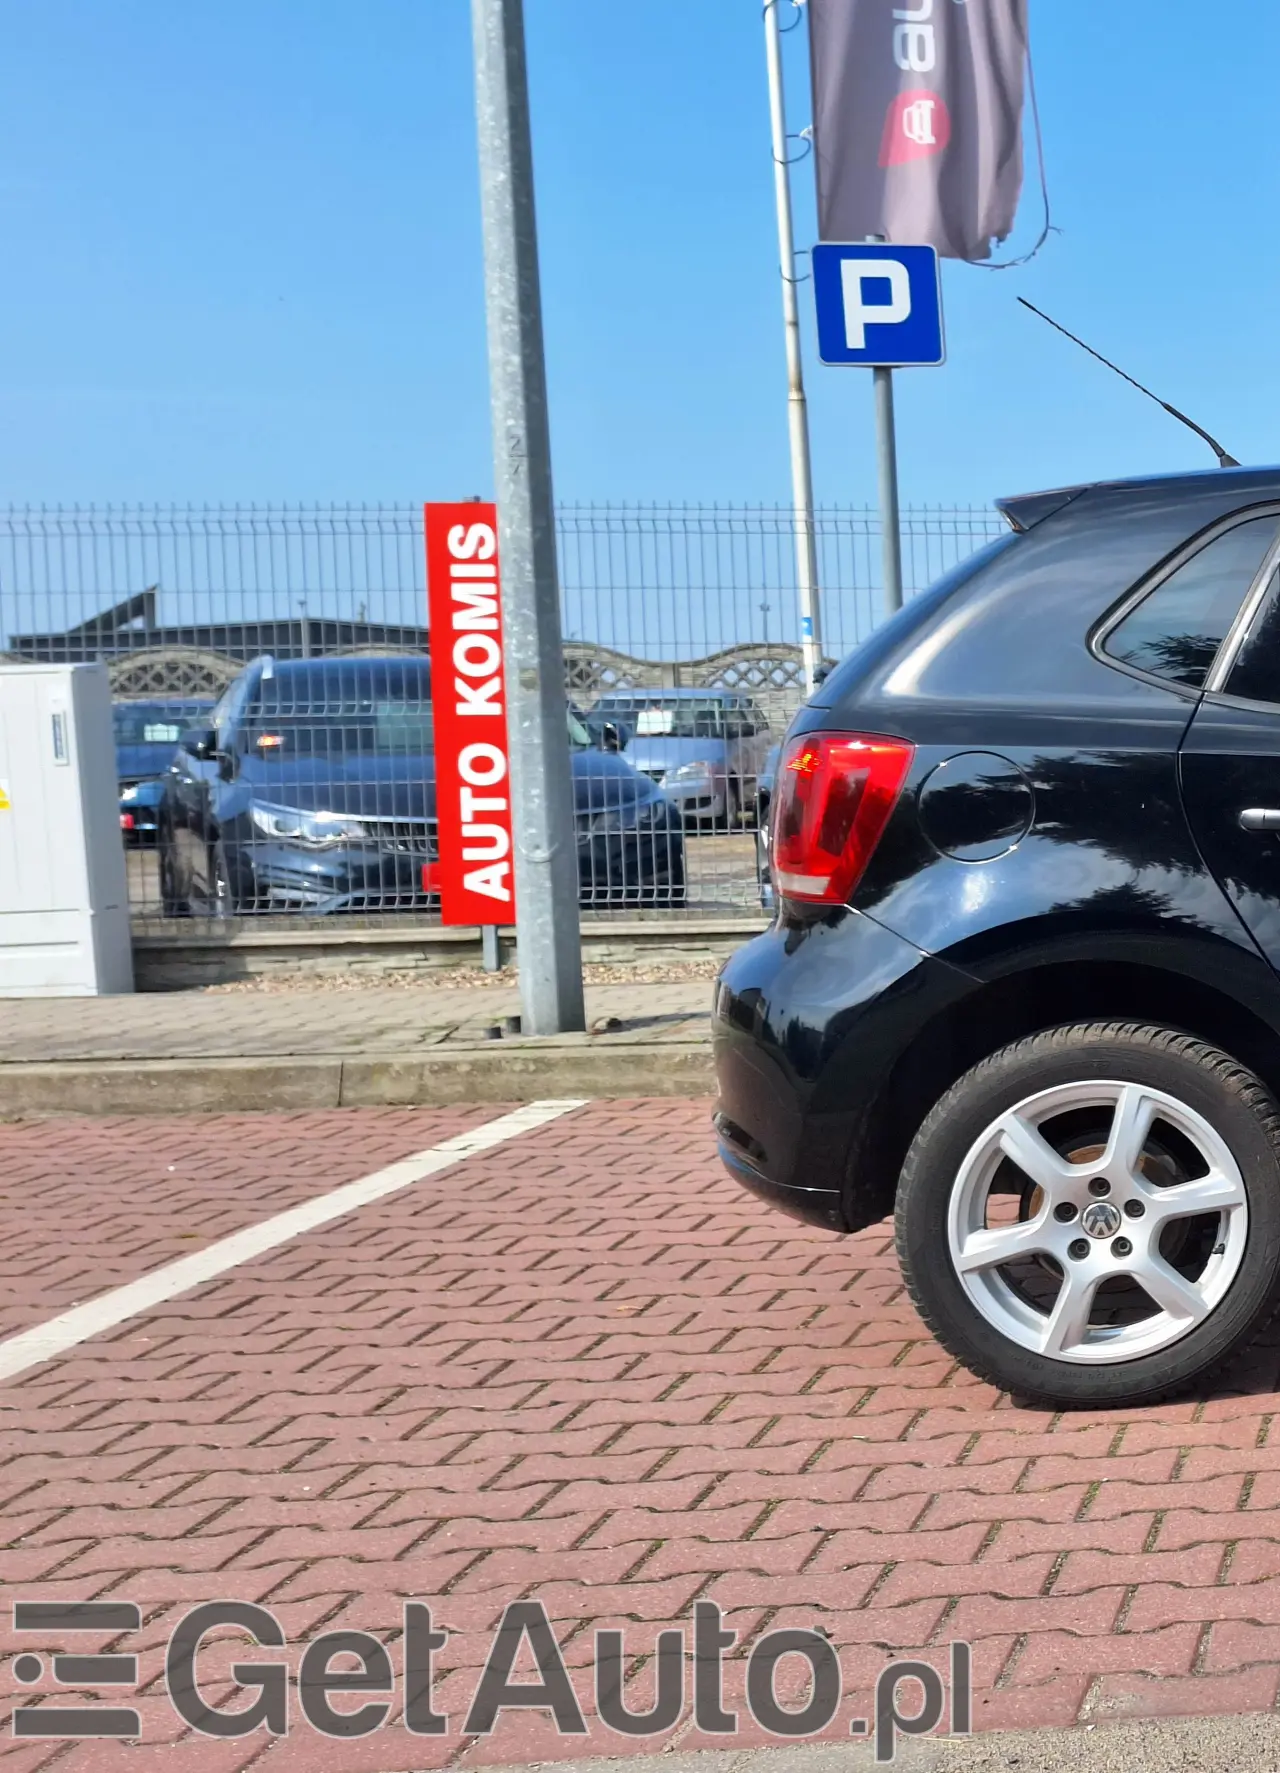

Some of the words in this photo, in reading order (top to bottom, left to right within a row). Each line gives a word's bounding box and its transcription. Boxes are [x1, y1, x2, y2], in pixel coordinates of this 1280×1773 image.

[840, 258, 911, 349] P
[447, 522, 504, 716] KOMIS
[457, 742, 511, 902] AUTO
